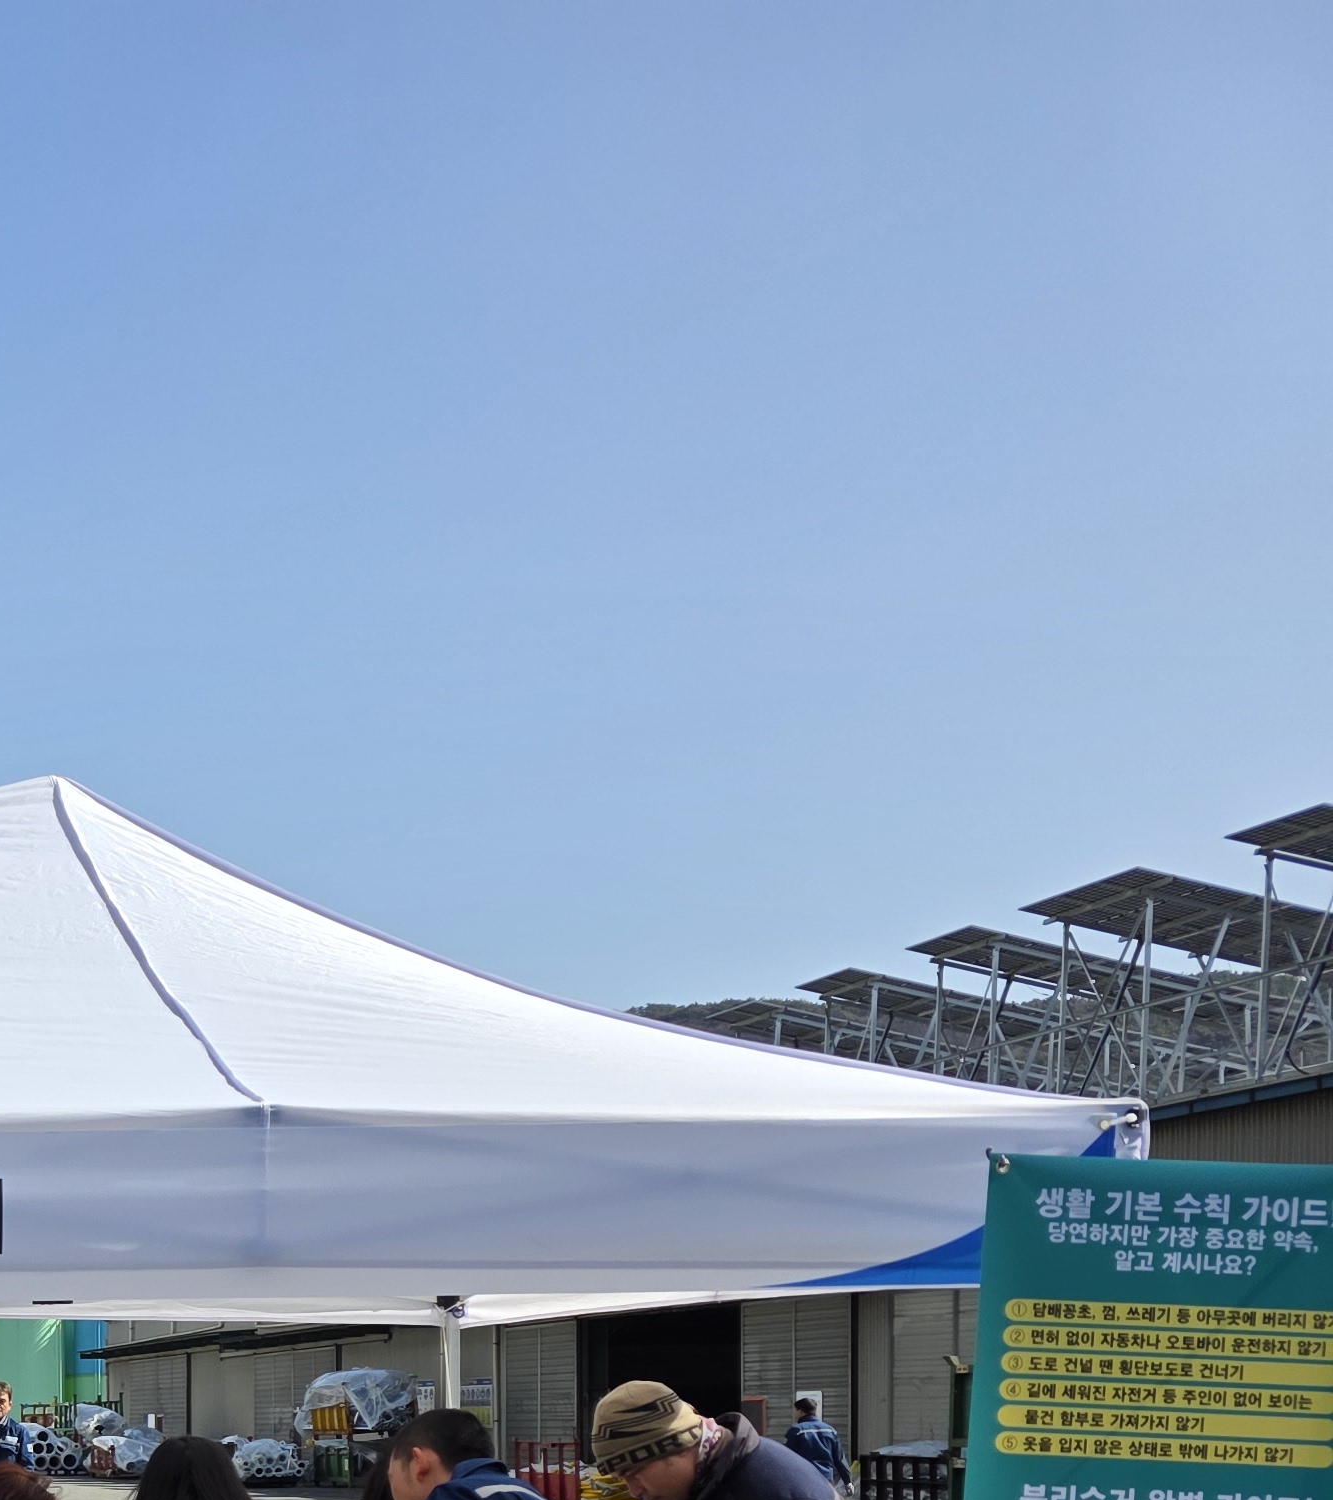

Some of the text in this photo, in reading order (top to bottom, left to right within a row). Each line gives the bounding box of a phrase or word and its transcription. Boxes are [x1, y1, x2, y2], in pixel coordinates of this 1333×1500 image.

[1035, 1187, 1096, 1219] 생활
[1105, 1190, 1163, 1221] 기본
[1173, 1193, 1231, 1225] 수칙
[1048, 1221, 1318, 1253] 당연하지만 가장 중요한 약속,
[1114, 1250, 1256, 1275] 알고 계시나요?
[1033, 1302, 1096, 1321] 담배꽁초,
[1102, 1305, 1120, 1322] 껌,
[1126, 1306, 1170, 1323] 쓰레기
[1176, 1308, 1191, 1324] 등
[1196, 1309, 1257, 1327] 아무곳에
[1262, 1311, 1307, 1329] 버리지
[1031, 1329, 1326, 1357] 면허 없이 자동차나 오토바이 운전하지 않기
[1028, 1356, 1244, 1380] 도로 건널 땐 횡단보도로 건너기
[1027, 1382, 1313, 1410] 길에 세워진 자전거 등 주인이 없어 보이는
[1024, 1409, 1205, 1433] 물건 함부로 가져가지 않기
[1023, 1435, 1294, 1464] 옷을 입지 않은 상태로 밖에 나가지 않기
